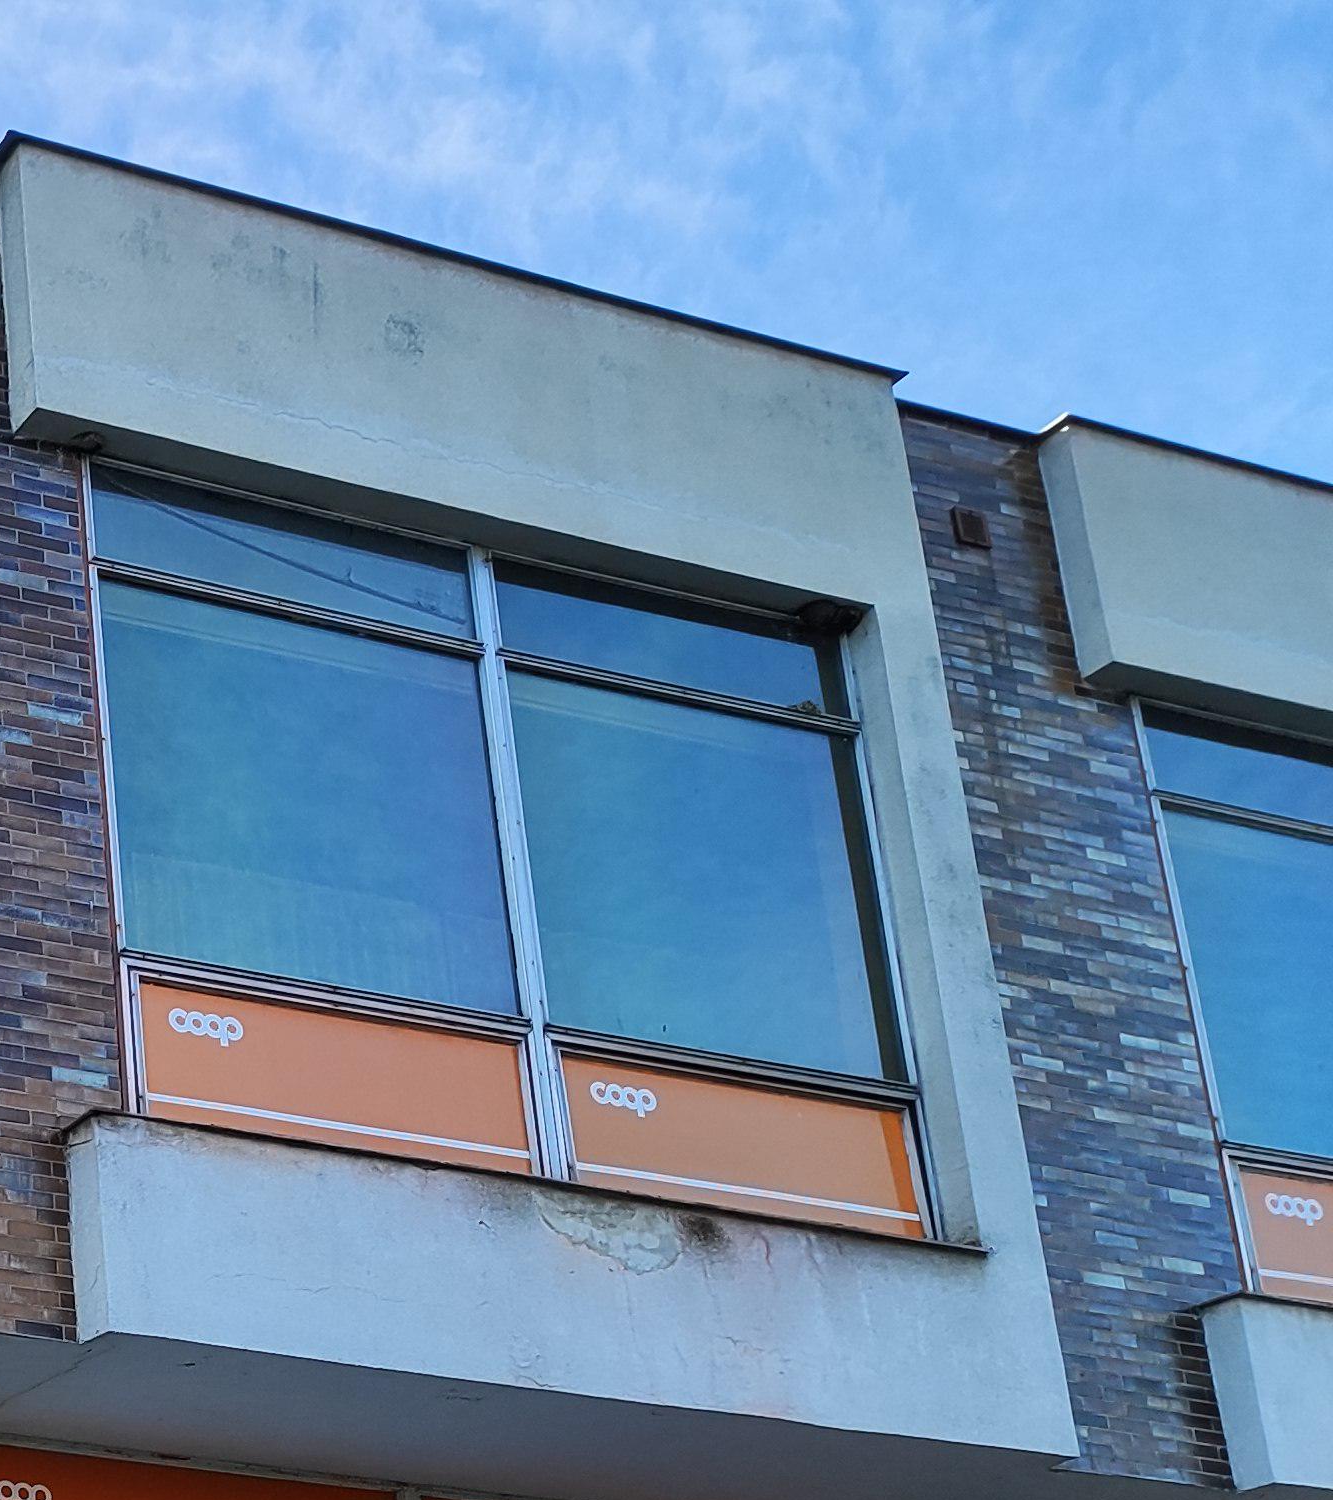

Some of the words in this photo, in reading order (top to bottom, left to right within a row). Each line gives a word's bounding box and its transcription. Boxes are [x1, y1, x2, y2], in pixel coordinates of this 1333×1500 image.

[168, 1007, 244, 1048] coop
[589, 1081, 658, 1118] coop
[1264, 1192, 1324, 1227] coop
